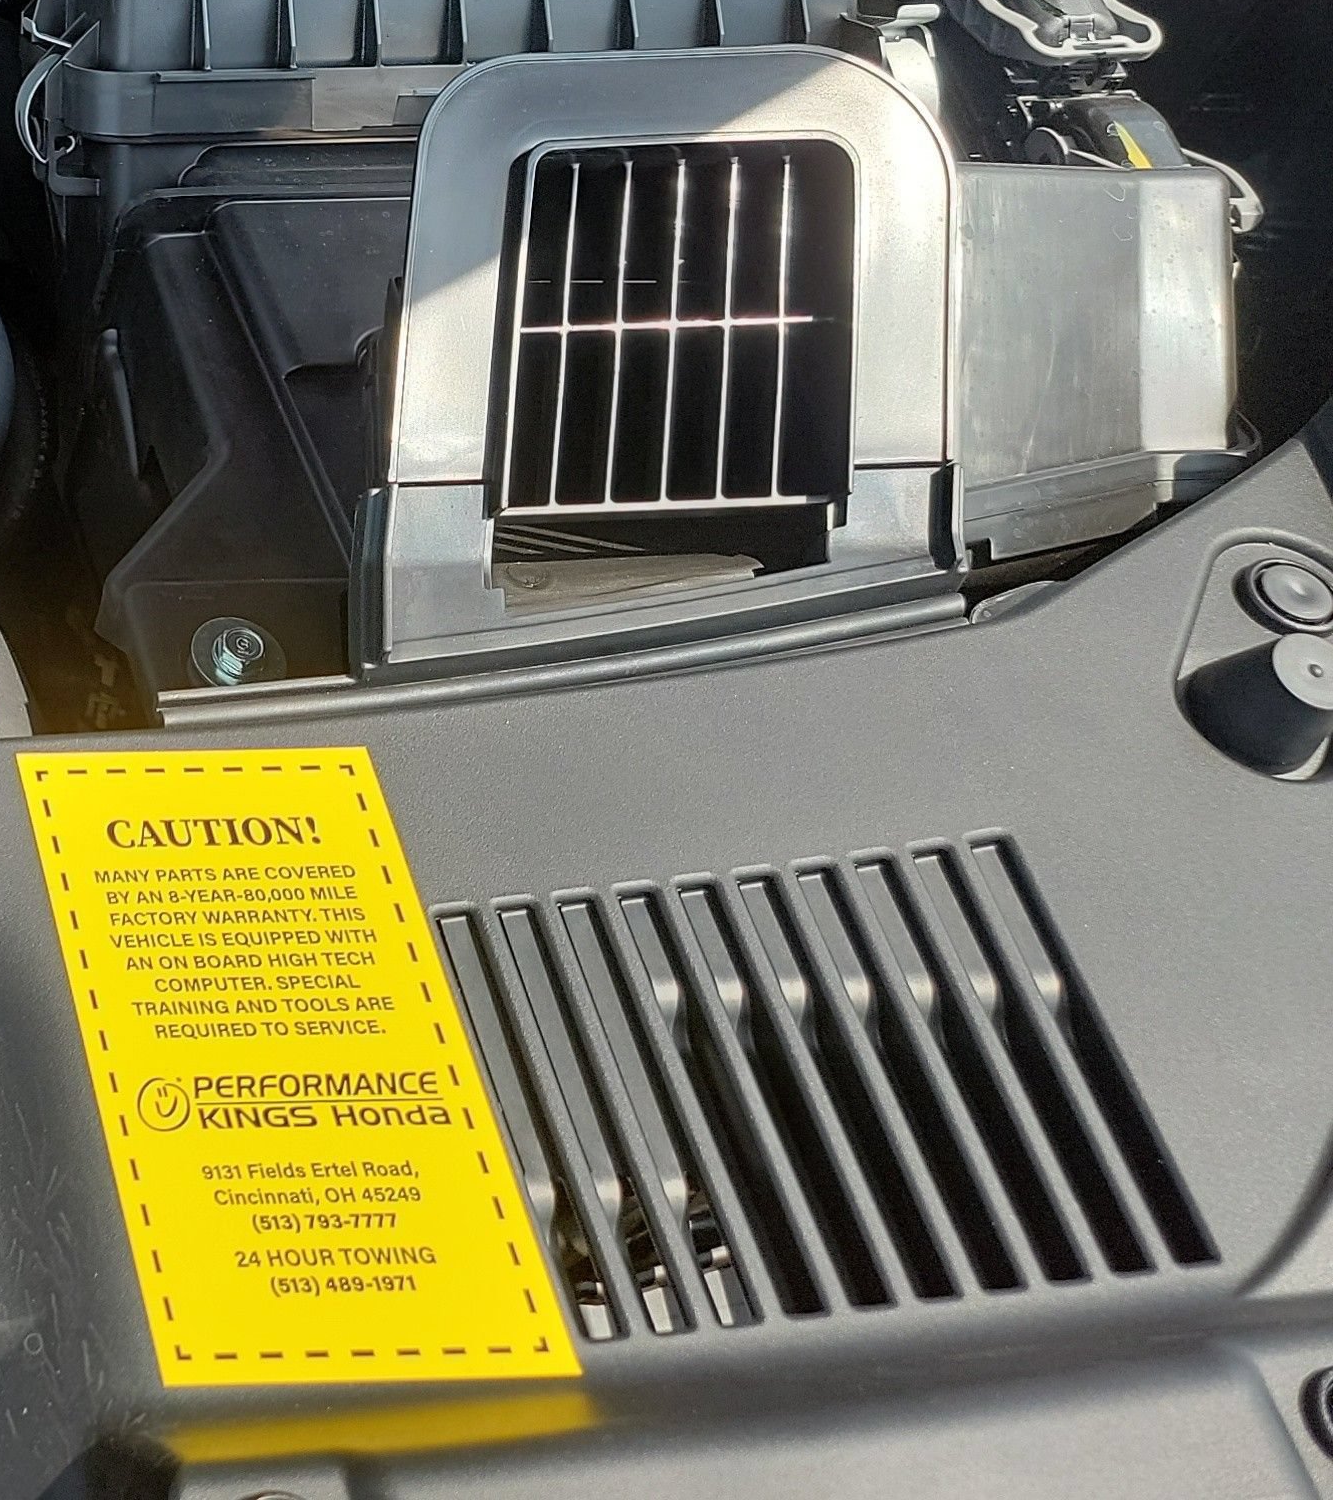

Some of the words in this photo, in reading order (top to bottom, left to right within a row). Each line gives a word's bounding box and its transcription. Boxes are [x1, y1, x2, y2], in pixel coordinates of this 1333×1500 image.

[106, 816, 320, 848] CAUTION!
[94, 869, 149, 882] MANY
[155, 868, 216, 882] PARTS
[222, 867, 260, 880] ARE
[264, 864, 355, 879] COVERED
[106, 891, 129, 904] BY
[137, 890, 163, 903] AN
[168, 887, 304, 903] 8-YEAR-80,000
[309, 885, 357, 900] MILE
[109, 911, 196, 925] FACTORY
[202, 908, 316, 924] WARRANTY.
[318, 907, 365, 921] THIS
[109, 933, 194, 948] VEHICLE
[198, 932, 217, 946] IS
[221, 930, 320, 947] EQUIPPED
[324, 928, 377, 943] WITH
[126, 956, 153, 970] AN
[158, 955, 188, 969] ON
[193, 954, 262, 968] BOARD
[267, 952, 317, 967] HIGH
[320, 951, 375, 965] TECH
[154, 976, 272, 992] COMPUTER.
[275, 974, 360, 989] SPECIAL
[131, 1000, 229, 1015] TRAINING
[235, 998, 277, 1013] AND
[280, 997, 349, 1012] TOOLS
[355, 996, 394, 1010] ARE
[154, 1022, 256, 1039] REQUIRED
[260, 1021, 288, 1036] TO
[293, 1019, 386, 1035] SERVICE.
[193, 1071, 438, 1098] PERFORMANCE
[200, 1106, 317, 1129] KINGS
[331, 1104, 452, 1127] Honda
[201, 1165, 241, 1179] 9131
[247, 1162, 306, 1178] Fields
[310, 1160, 357, 1177] Ertel
[361, 1159, 418, 1178] Road,
[214, 1187, 319, 1205] Cincinnati,
[324, 1187, 356, 1202] OH
[362, 1186, 420, 1202] 45249
[252, 1213, 300, 1233] (513)
[304, 1213, 396, 1228] 793-7777
[234, 1251, 261, 1267] 24
[266, 1248, 334, 1266] HOUR
[337, 1246, 436, 1265] TOWING
[270, 1276, 319, 1297] (513)
[325, 1275, 416, 1291] 489-1971
